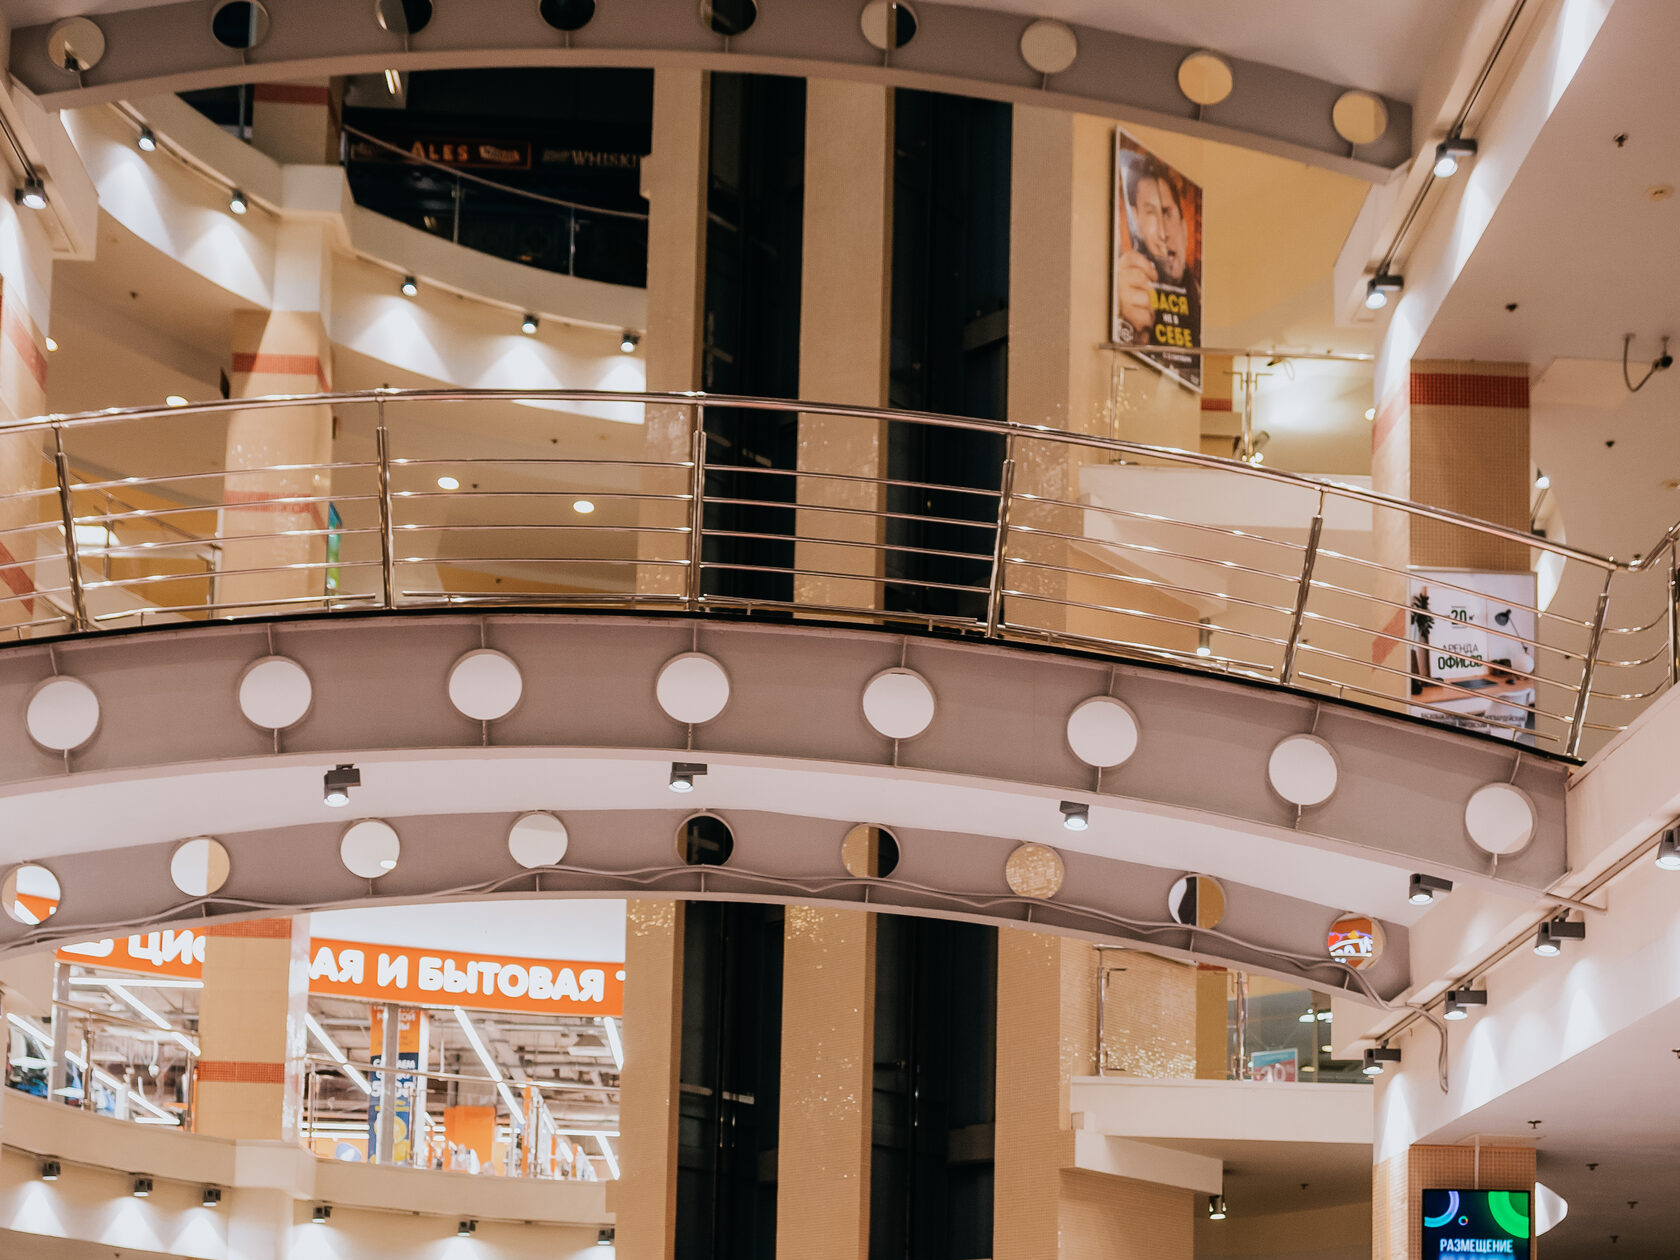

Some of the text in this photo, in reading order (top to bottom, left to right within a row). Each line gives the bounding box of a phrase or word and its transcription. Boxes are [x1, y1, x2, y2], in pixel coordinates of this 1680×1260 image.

[411, 140, 469, 162] ALES
[1155, 323, 1193, 348] СЕБЕ
[377, 952, 409, 989] И
[418, 955, 605, 1003] БЫТОВАЯ
[1439, 1238, 1514, 1253] РАЗМЕЩЕНИЕ
